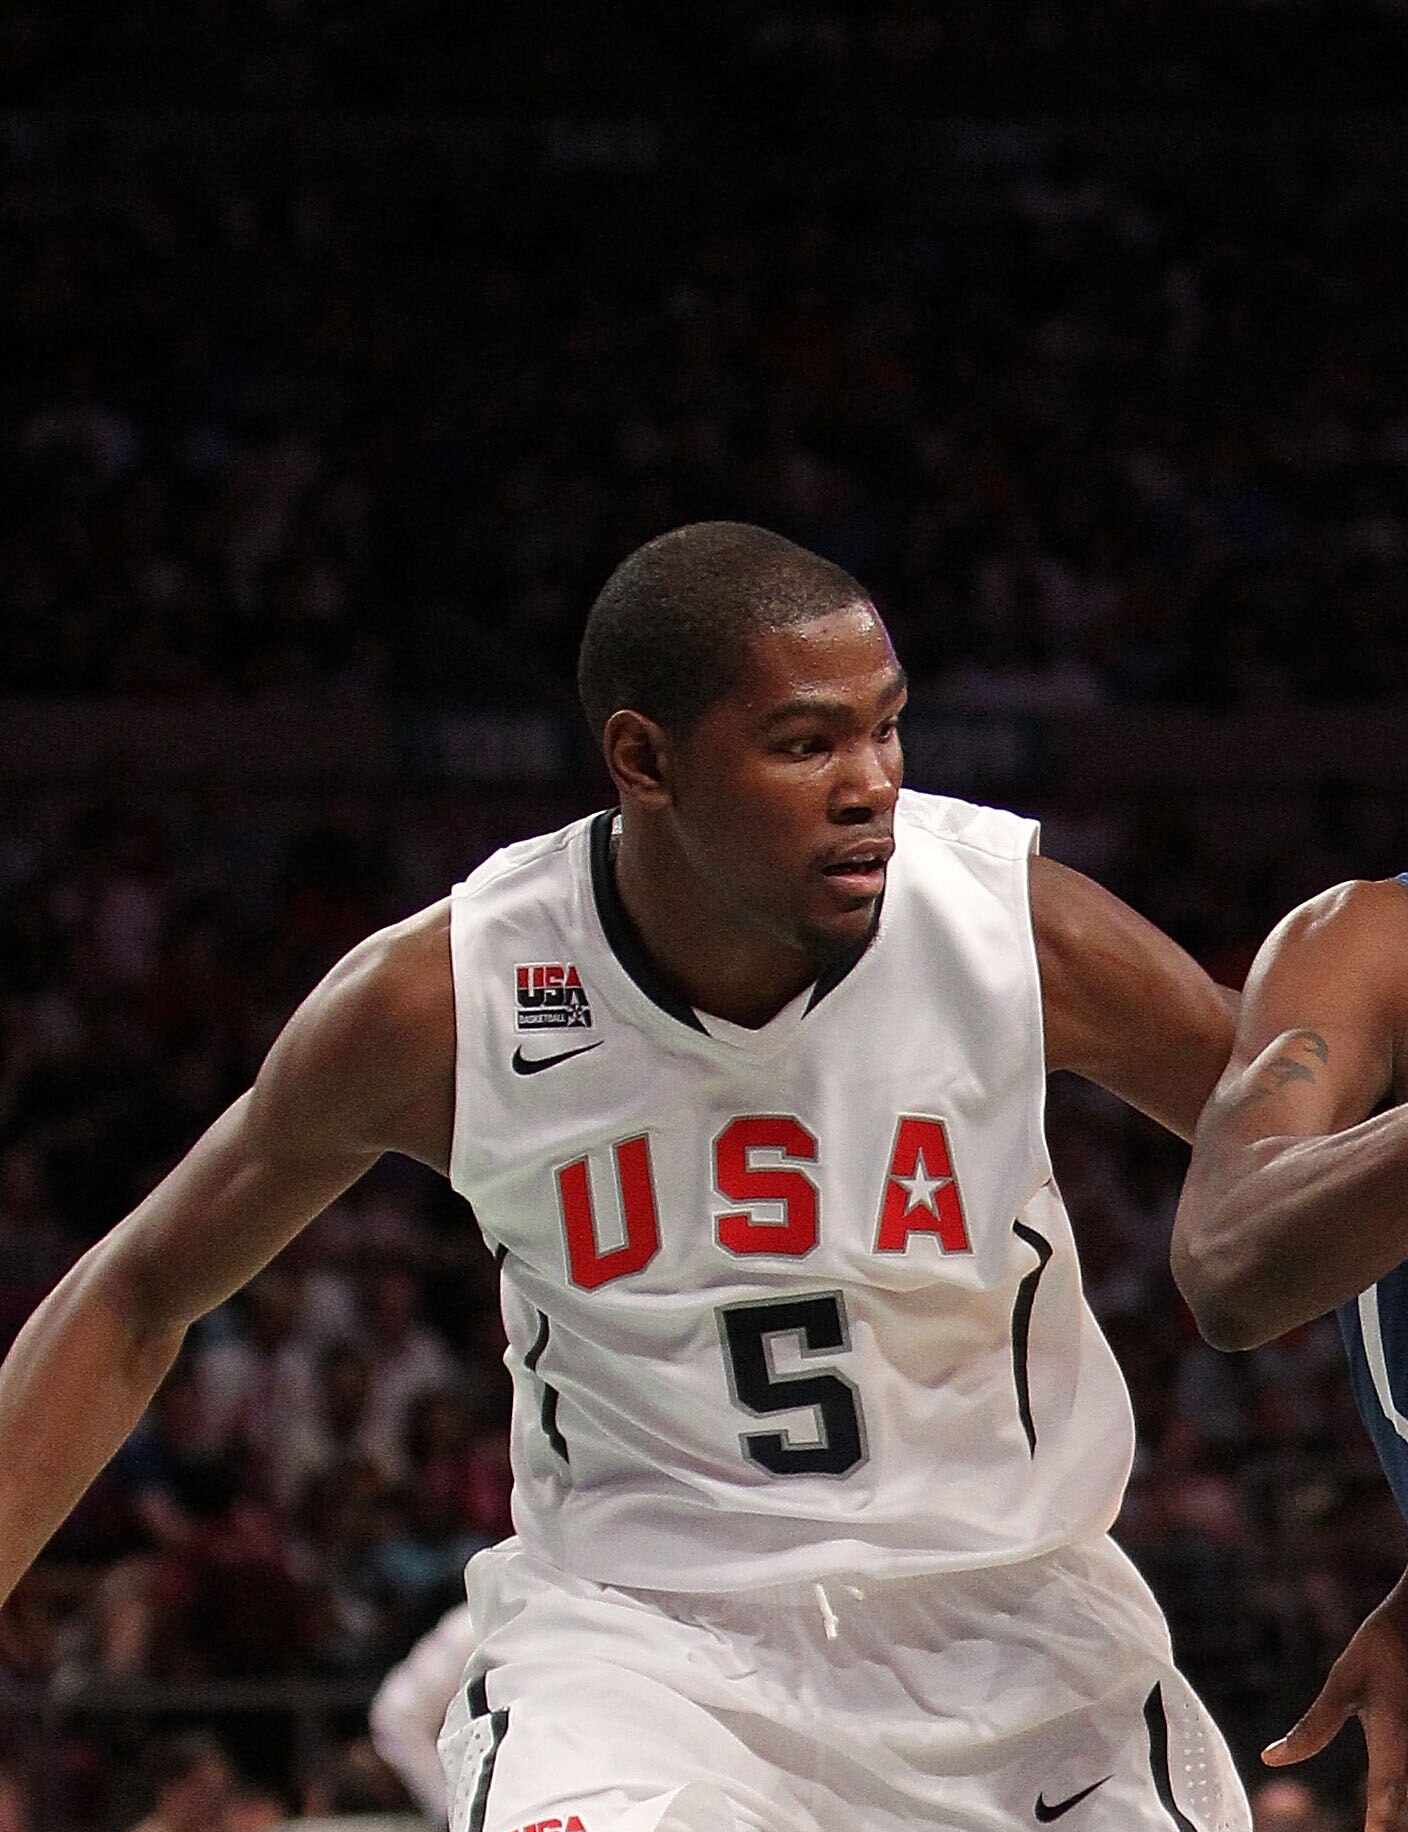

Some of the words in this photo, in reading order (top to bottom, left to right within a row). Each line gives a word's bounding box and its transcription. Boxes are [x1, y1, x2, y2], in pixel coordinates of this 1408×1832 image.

[517, 966, 589, 1007] USA
[553, 1113, 974, 1294] USA
[714, 1290, 871, 1479] 5
